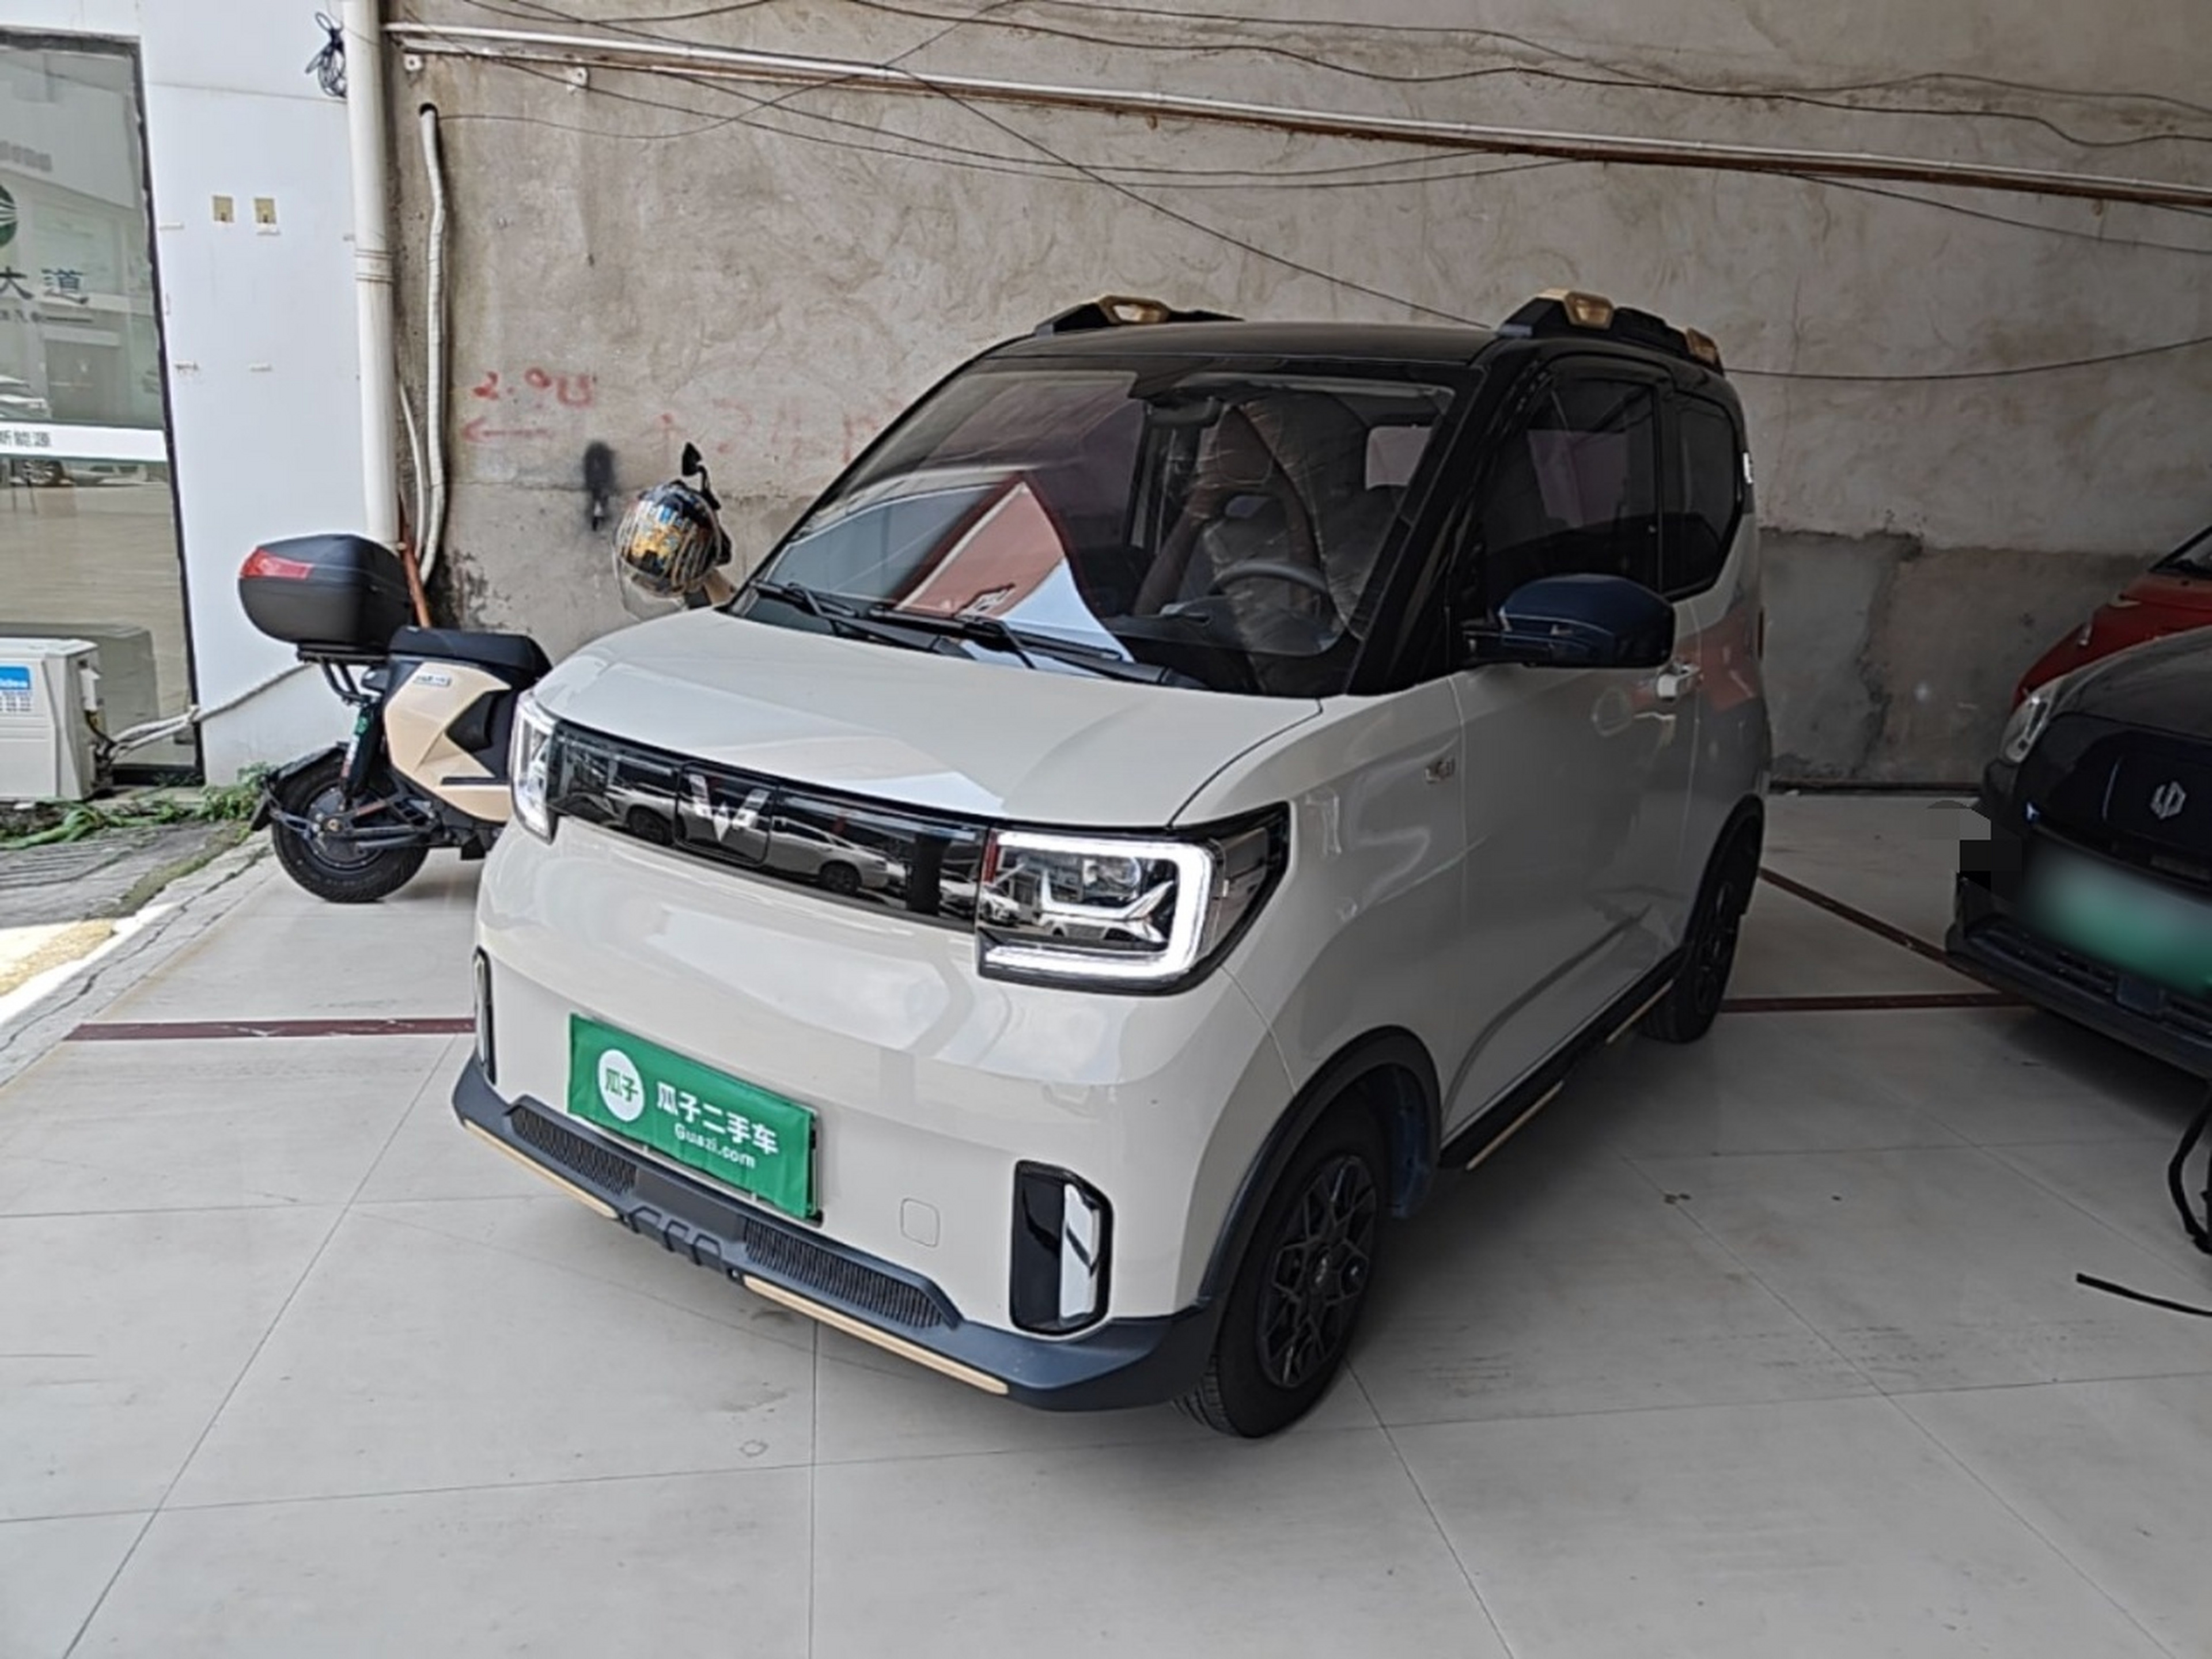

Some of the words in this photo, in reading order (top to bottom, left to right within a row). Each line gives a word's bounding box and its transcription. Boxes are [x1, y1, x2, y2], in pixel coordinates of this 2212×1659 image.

[605, 1067, 638, 1103] 瓜子
[656, 1081, 778, 1155] 瓜子二手车
[674, 1123, 755, 1169] Guazi.com
